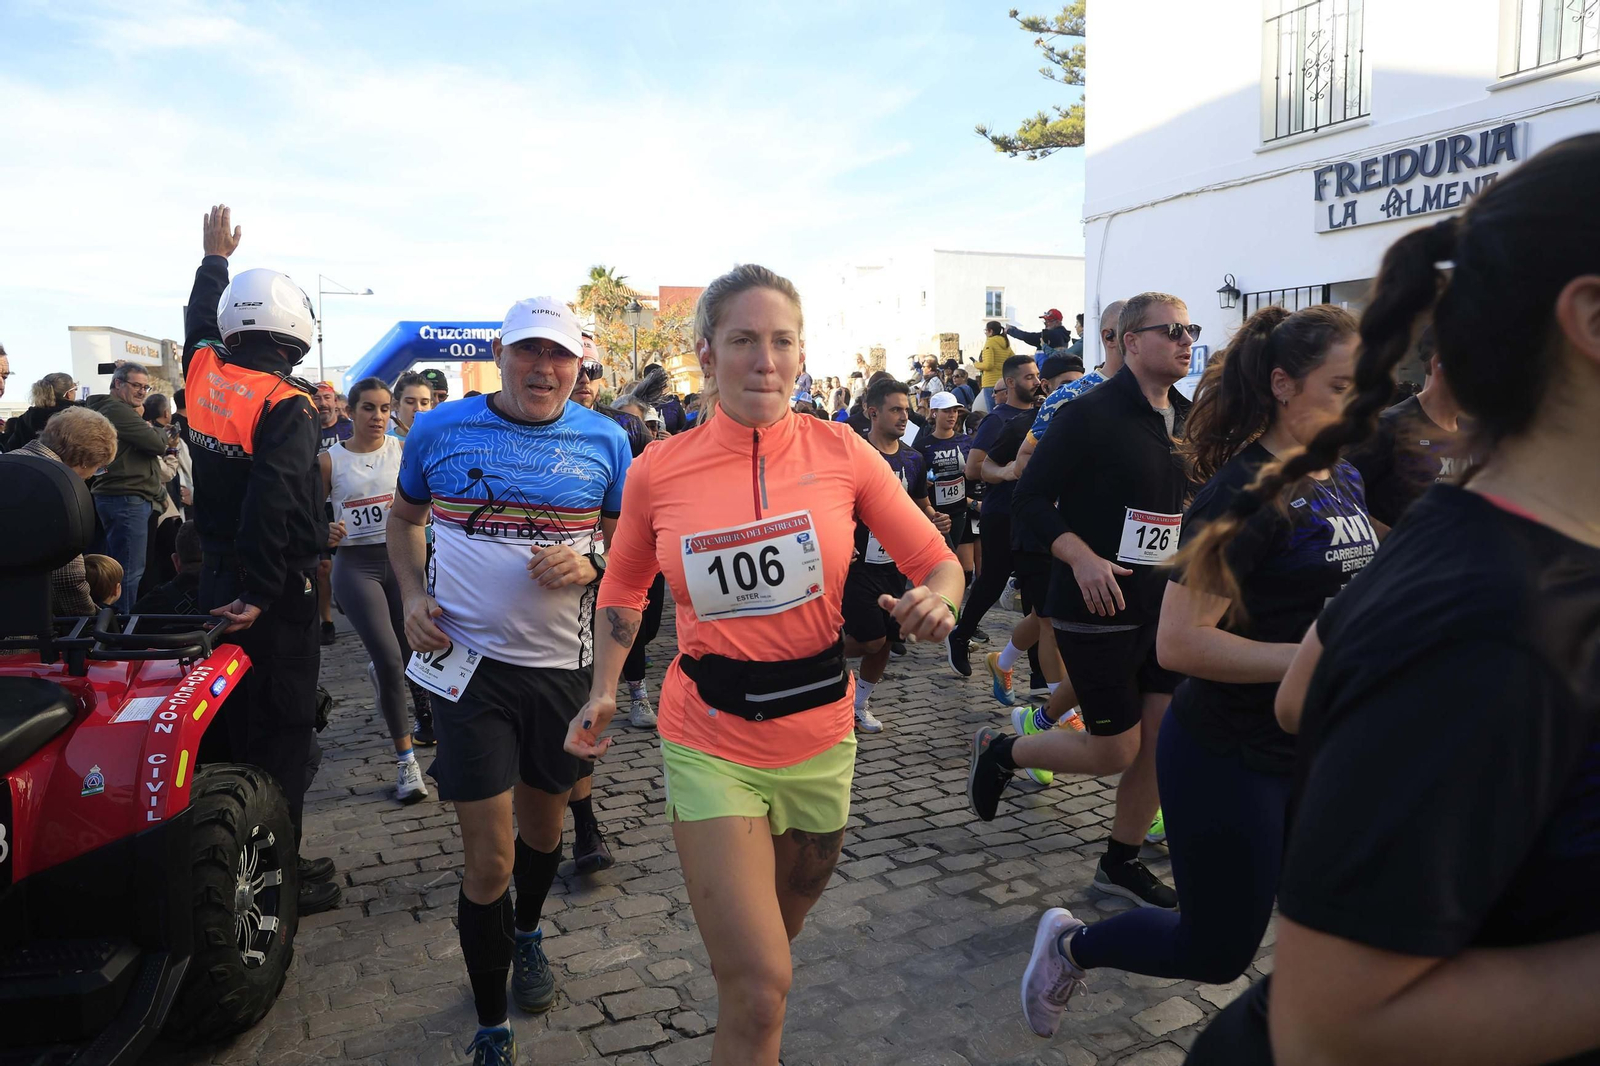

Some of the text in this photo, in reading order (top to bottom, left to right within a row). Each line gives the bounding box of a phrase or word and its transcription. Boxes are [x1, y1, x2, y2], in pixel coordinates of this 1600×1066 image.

[1314, 122, 1516, 201] FREIDURIA
[1328, 199, 1357, 229] LA
[531, 308, 561, 318] KIPRUN
[450, 343, 476, 357] 0.0
[934, 448, 957, 460] XVI
[941, 485, 959, 498] 148
[351, 505, 383, 526] 319
[707, 533, 746, 545] CARRERA
[747, 529, 762, 538] DEL
[764, 517, 808, 534] ESTRECHO
[1136, 525, 1170, 550] 126
[1326, 514, 1371, 546] XVI
[1325, 544, 1374, 562] CARRERA DEL
[707, 545, 785, 595] 106
[736, 592, 760, 602] ESTER
[154, 666, 214, 734] PROTECCION
[146, 753, 167, 822] CIVIL
